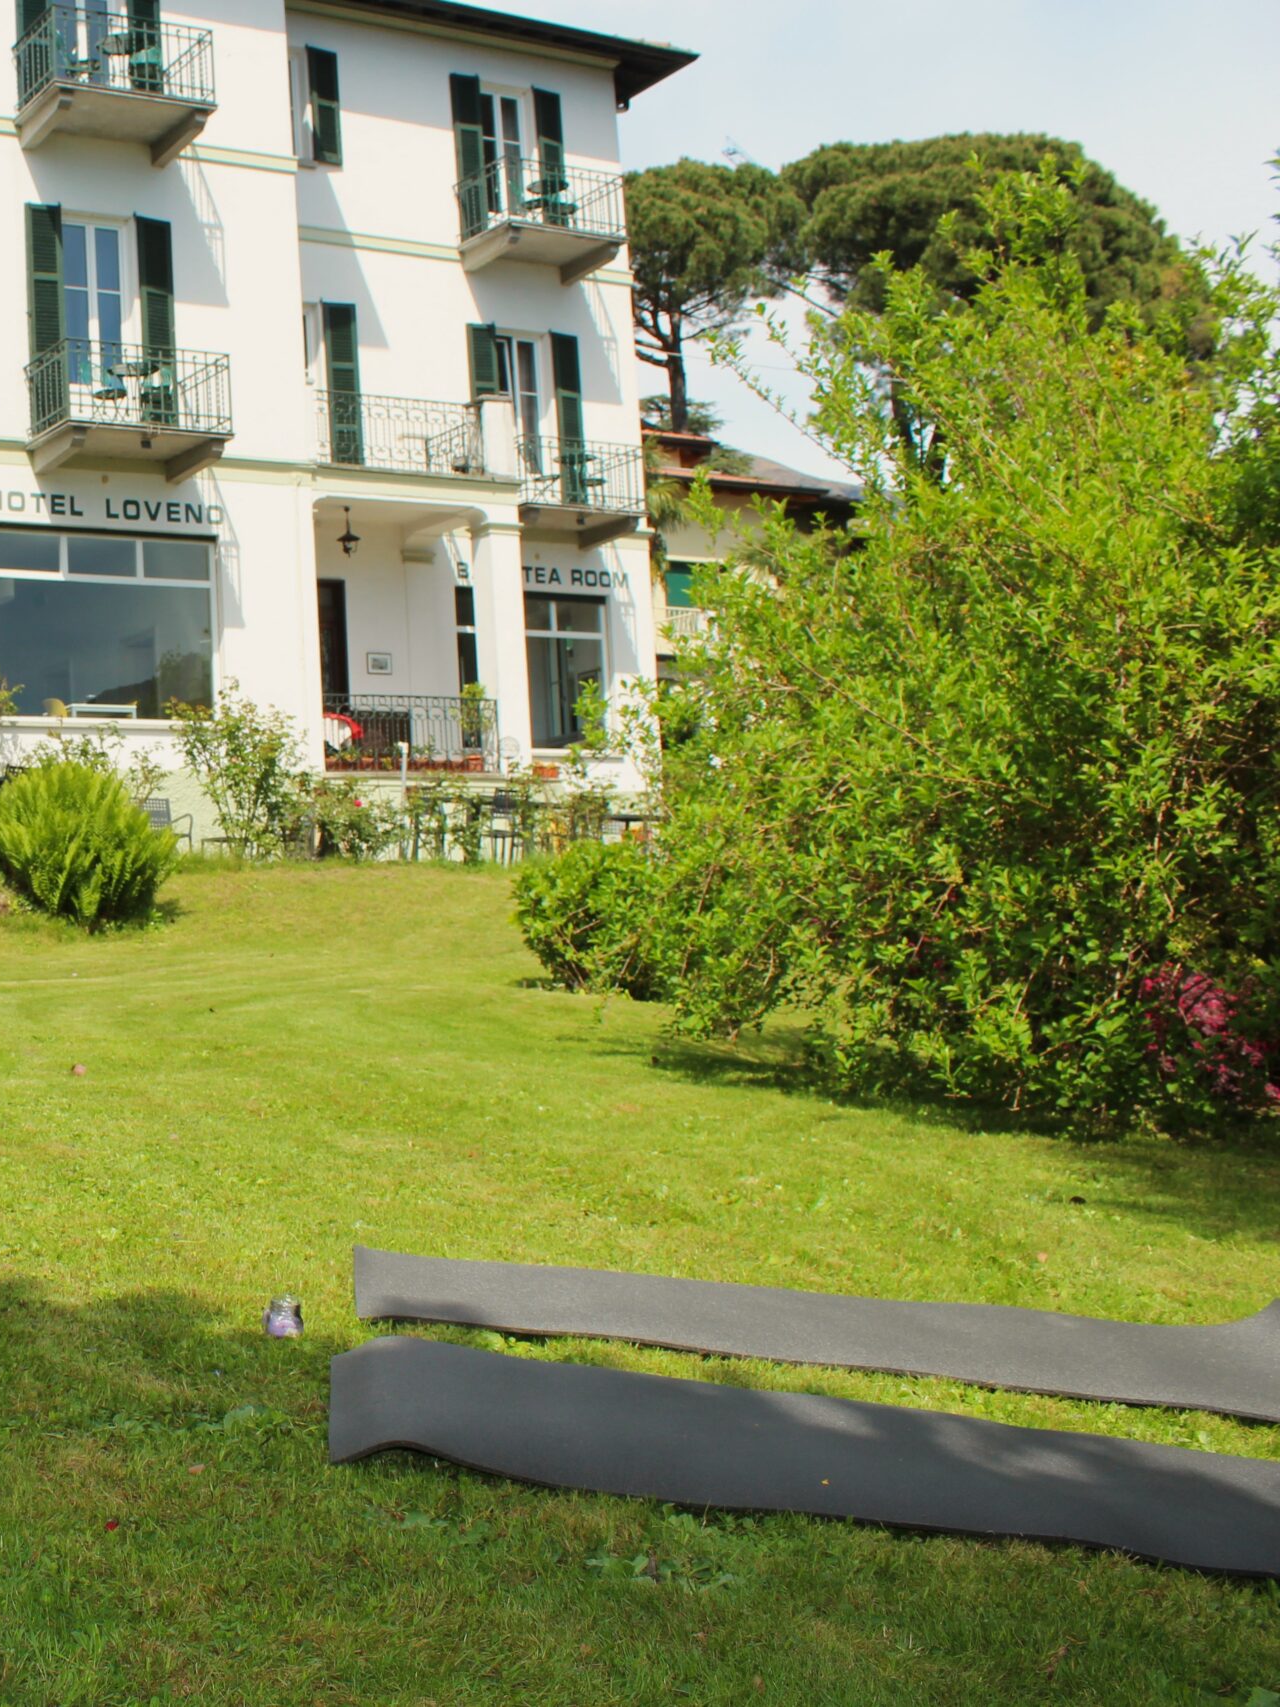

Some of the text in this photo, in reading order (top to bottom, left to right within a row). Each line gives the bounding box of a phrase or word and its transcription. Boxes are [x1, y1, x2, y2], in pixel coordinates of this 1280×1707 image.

[105, 498, 225, 525] LOVENO
[522, 566, 562, 585] TEA
[571, 569, 629, 589] ROOM
